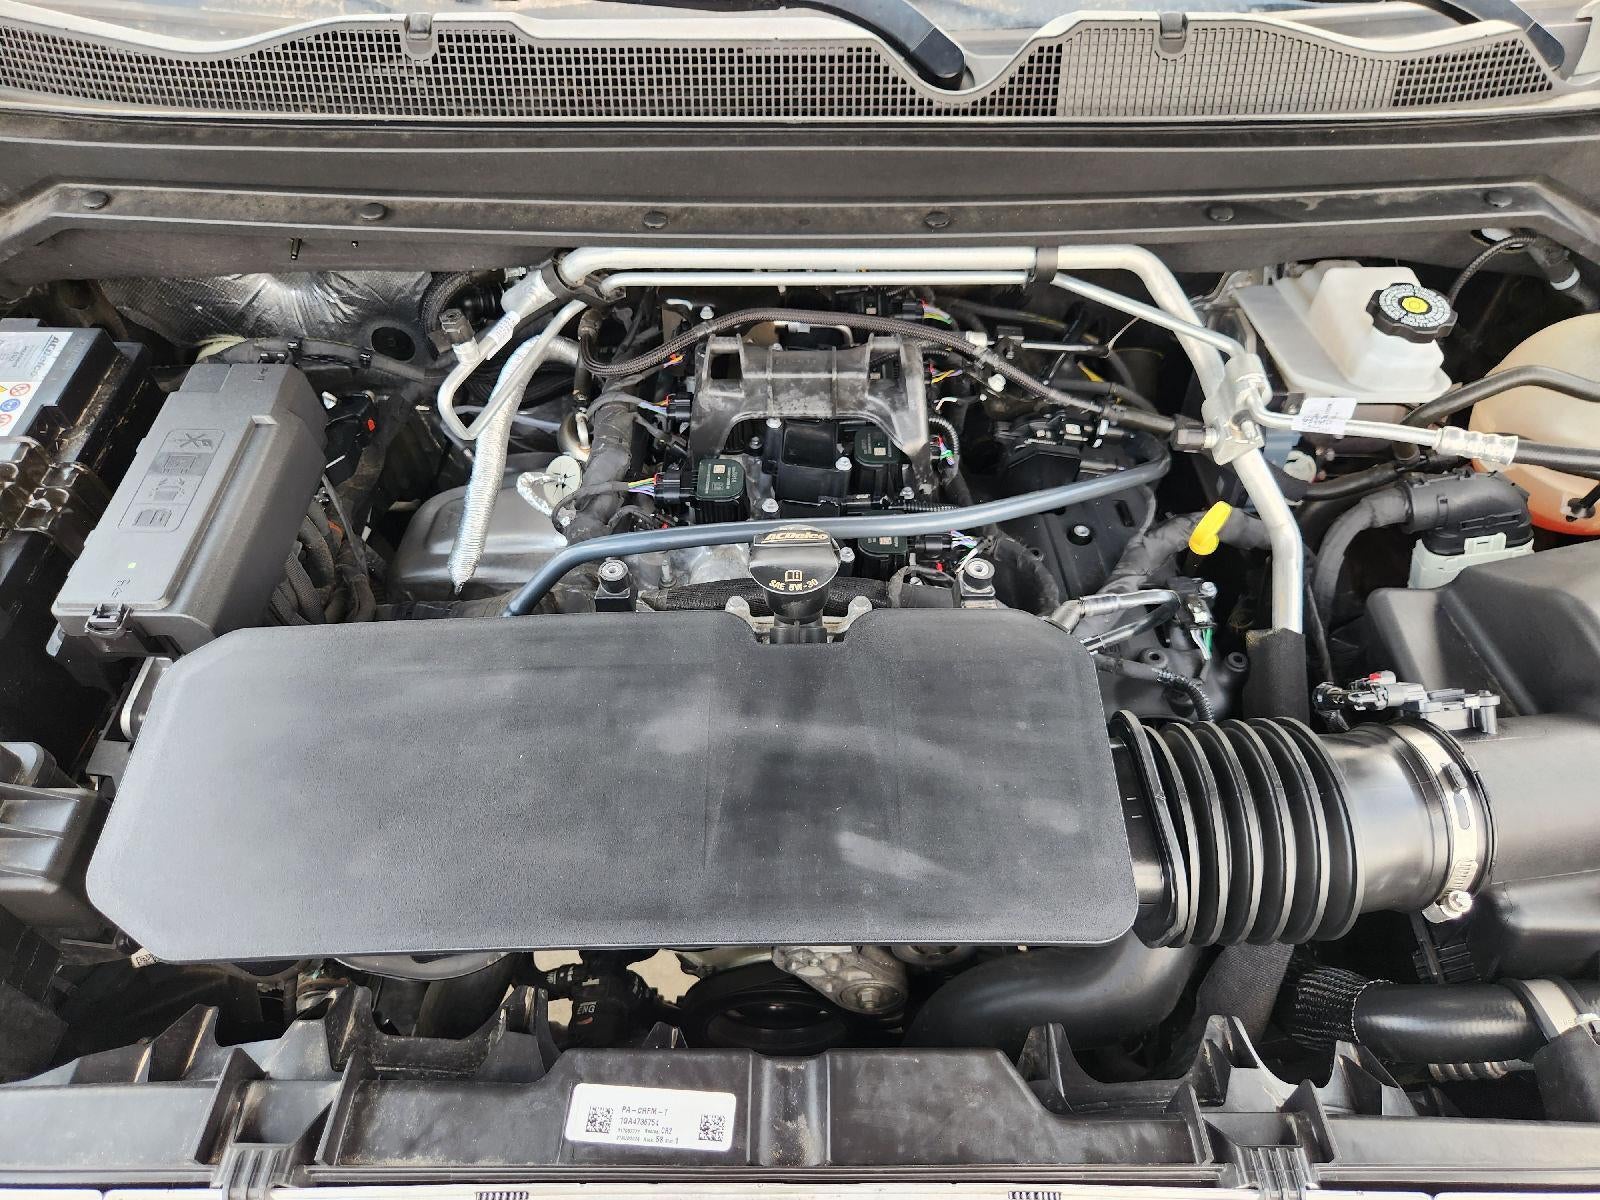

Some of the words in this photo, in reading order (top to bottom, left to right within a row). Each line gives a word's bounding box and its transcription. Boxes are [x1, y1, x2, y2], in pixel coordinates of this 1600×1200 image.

[763, 532, 829, 543] ACDelco
[769, 580, 786, 591] SAE
[788, 578, 818, 591] 5W-30
